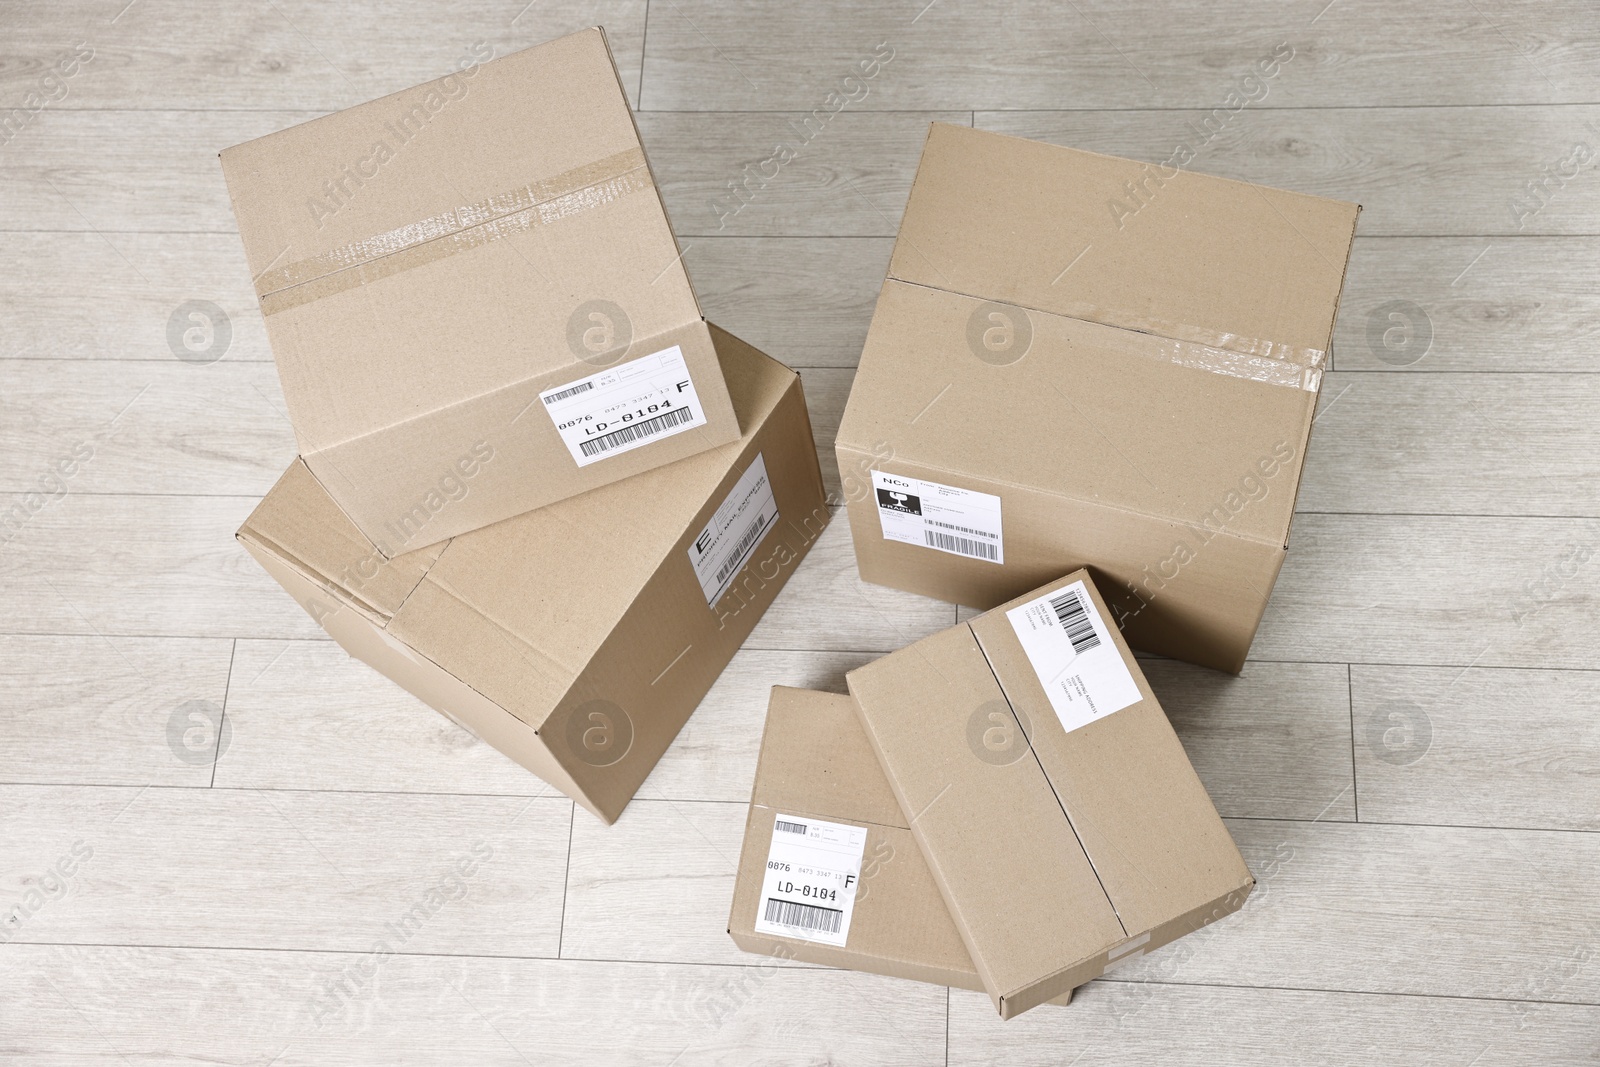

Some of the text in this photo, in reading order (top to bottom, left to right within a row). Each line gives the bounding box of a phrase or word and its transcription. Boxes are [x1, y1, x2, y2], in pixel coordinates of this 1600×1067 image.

[675, 379, 691, 393] F
[584, 399, 672, 435] LD-0104
[882, 477, 909, 487] NCo
[697, 530, 723, 567] PRIORITY
[724, 511, 737, 531] MAIL
[737, 474, 764, 512] EXPRESS
[880, 502, 920, 515] FRAGILE
[695, 528, 711, 555] E
[1074, 587, 1091, 614] 1234567890
[1038, 603, 1053, 627] SENT FROM
[1074, 674, 1097, 714] SHIPPING ADDRESS
[767, 860, 791, 872] 0876
[844, 874, 855, 889] F
[777, 880, 836, 900] LD-0104
